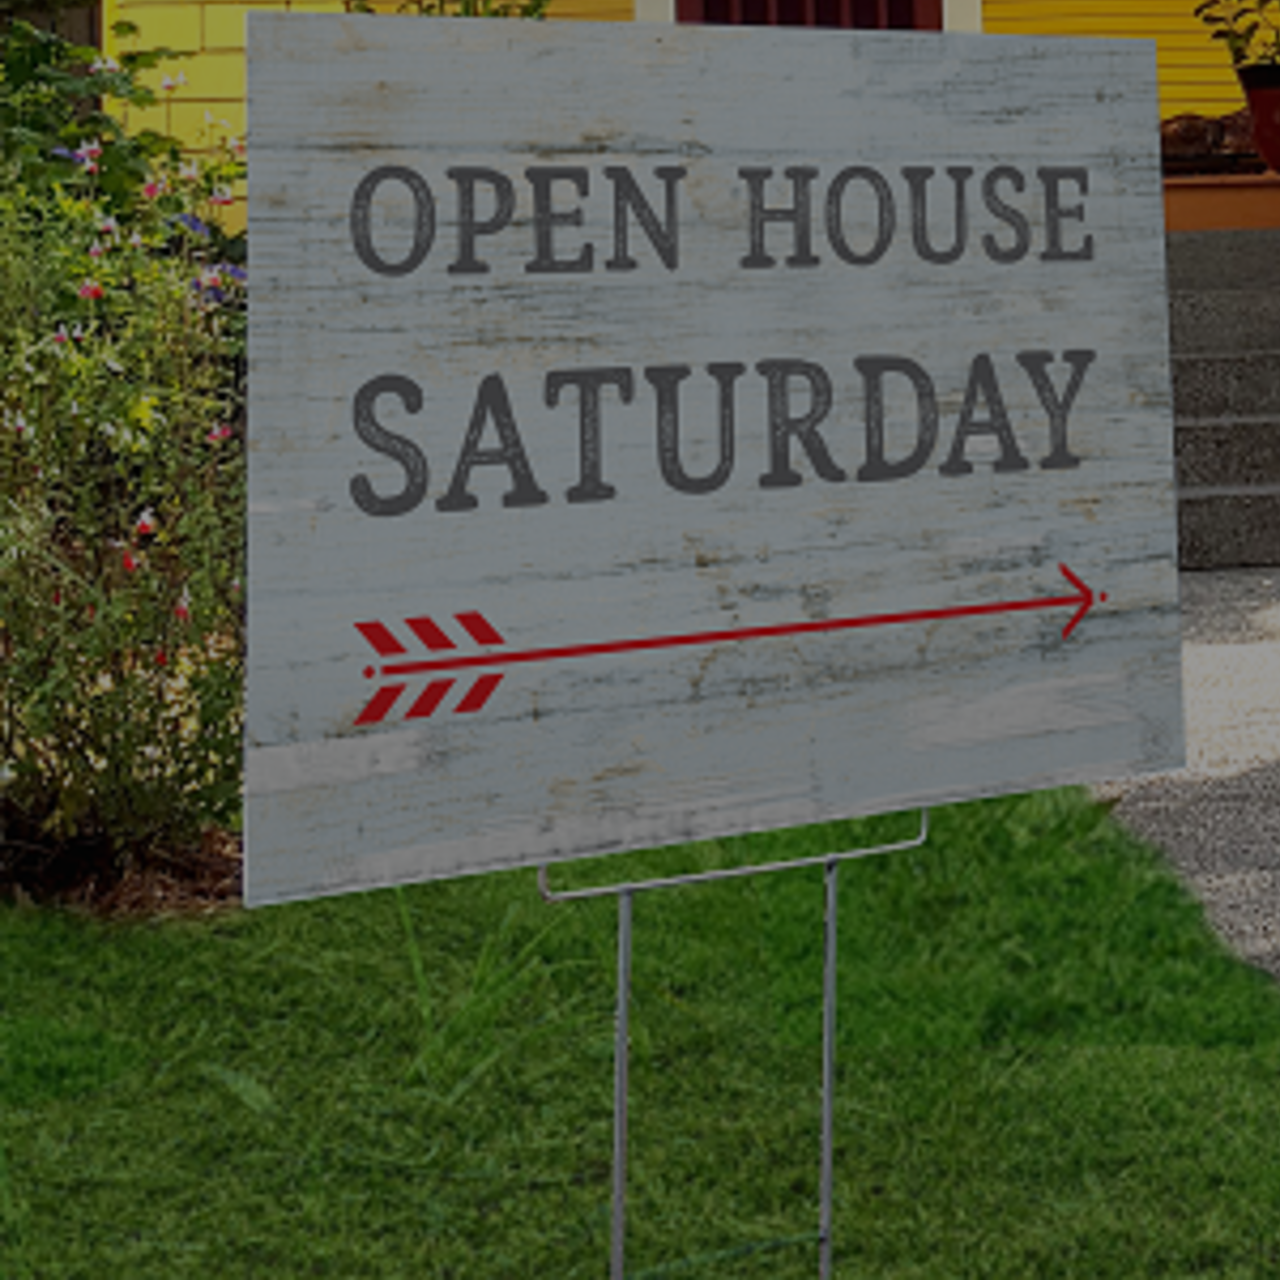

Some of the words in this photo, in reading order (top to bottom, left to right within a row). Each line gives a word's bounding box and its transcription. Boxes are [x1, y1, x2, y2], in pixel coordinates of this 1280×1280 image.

[350, 165, 688, 277] OPEN
[737, 165, 1094, 269] HOUSE
[350, 349, 1097, 517] SATURDAY
